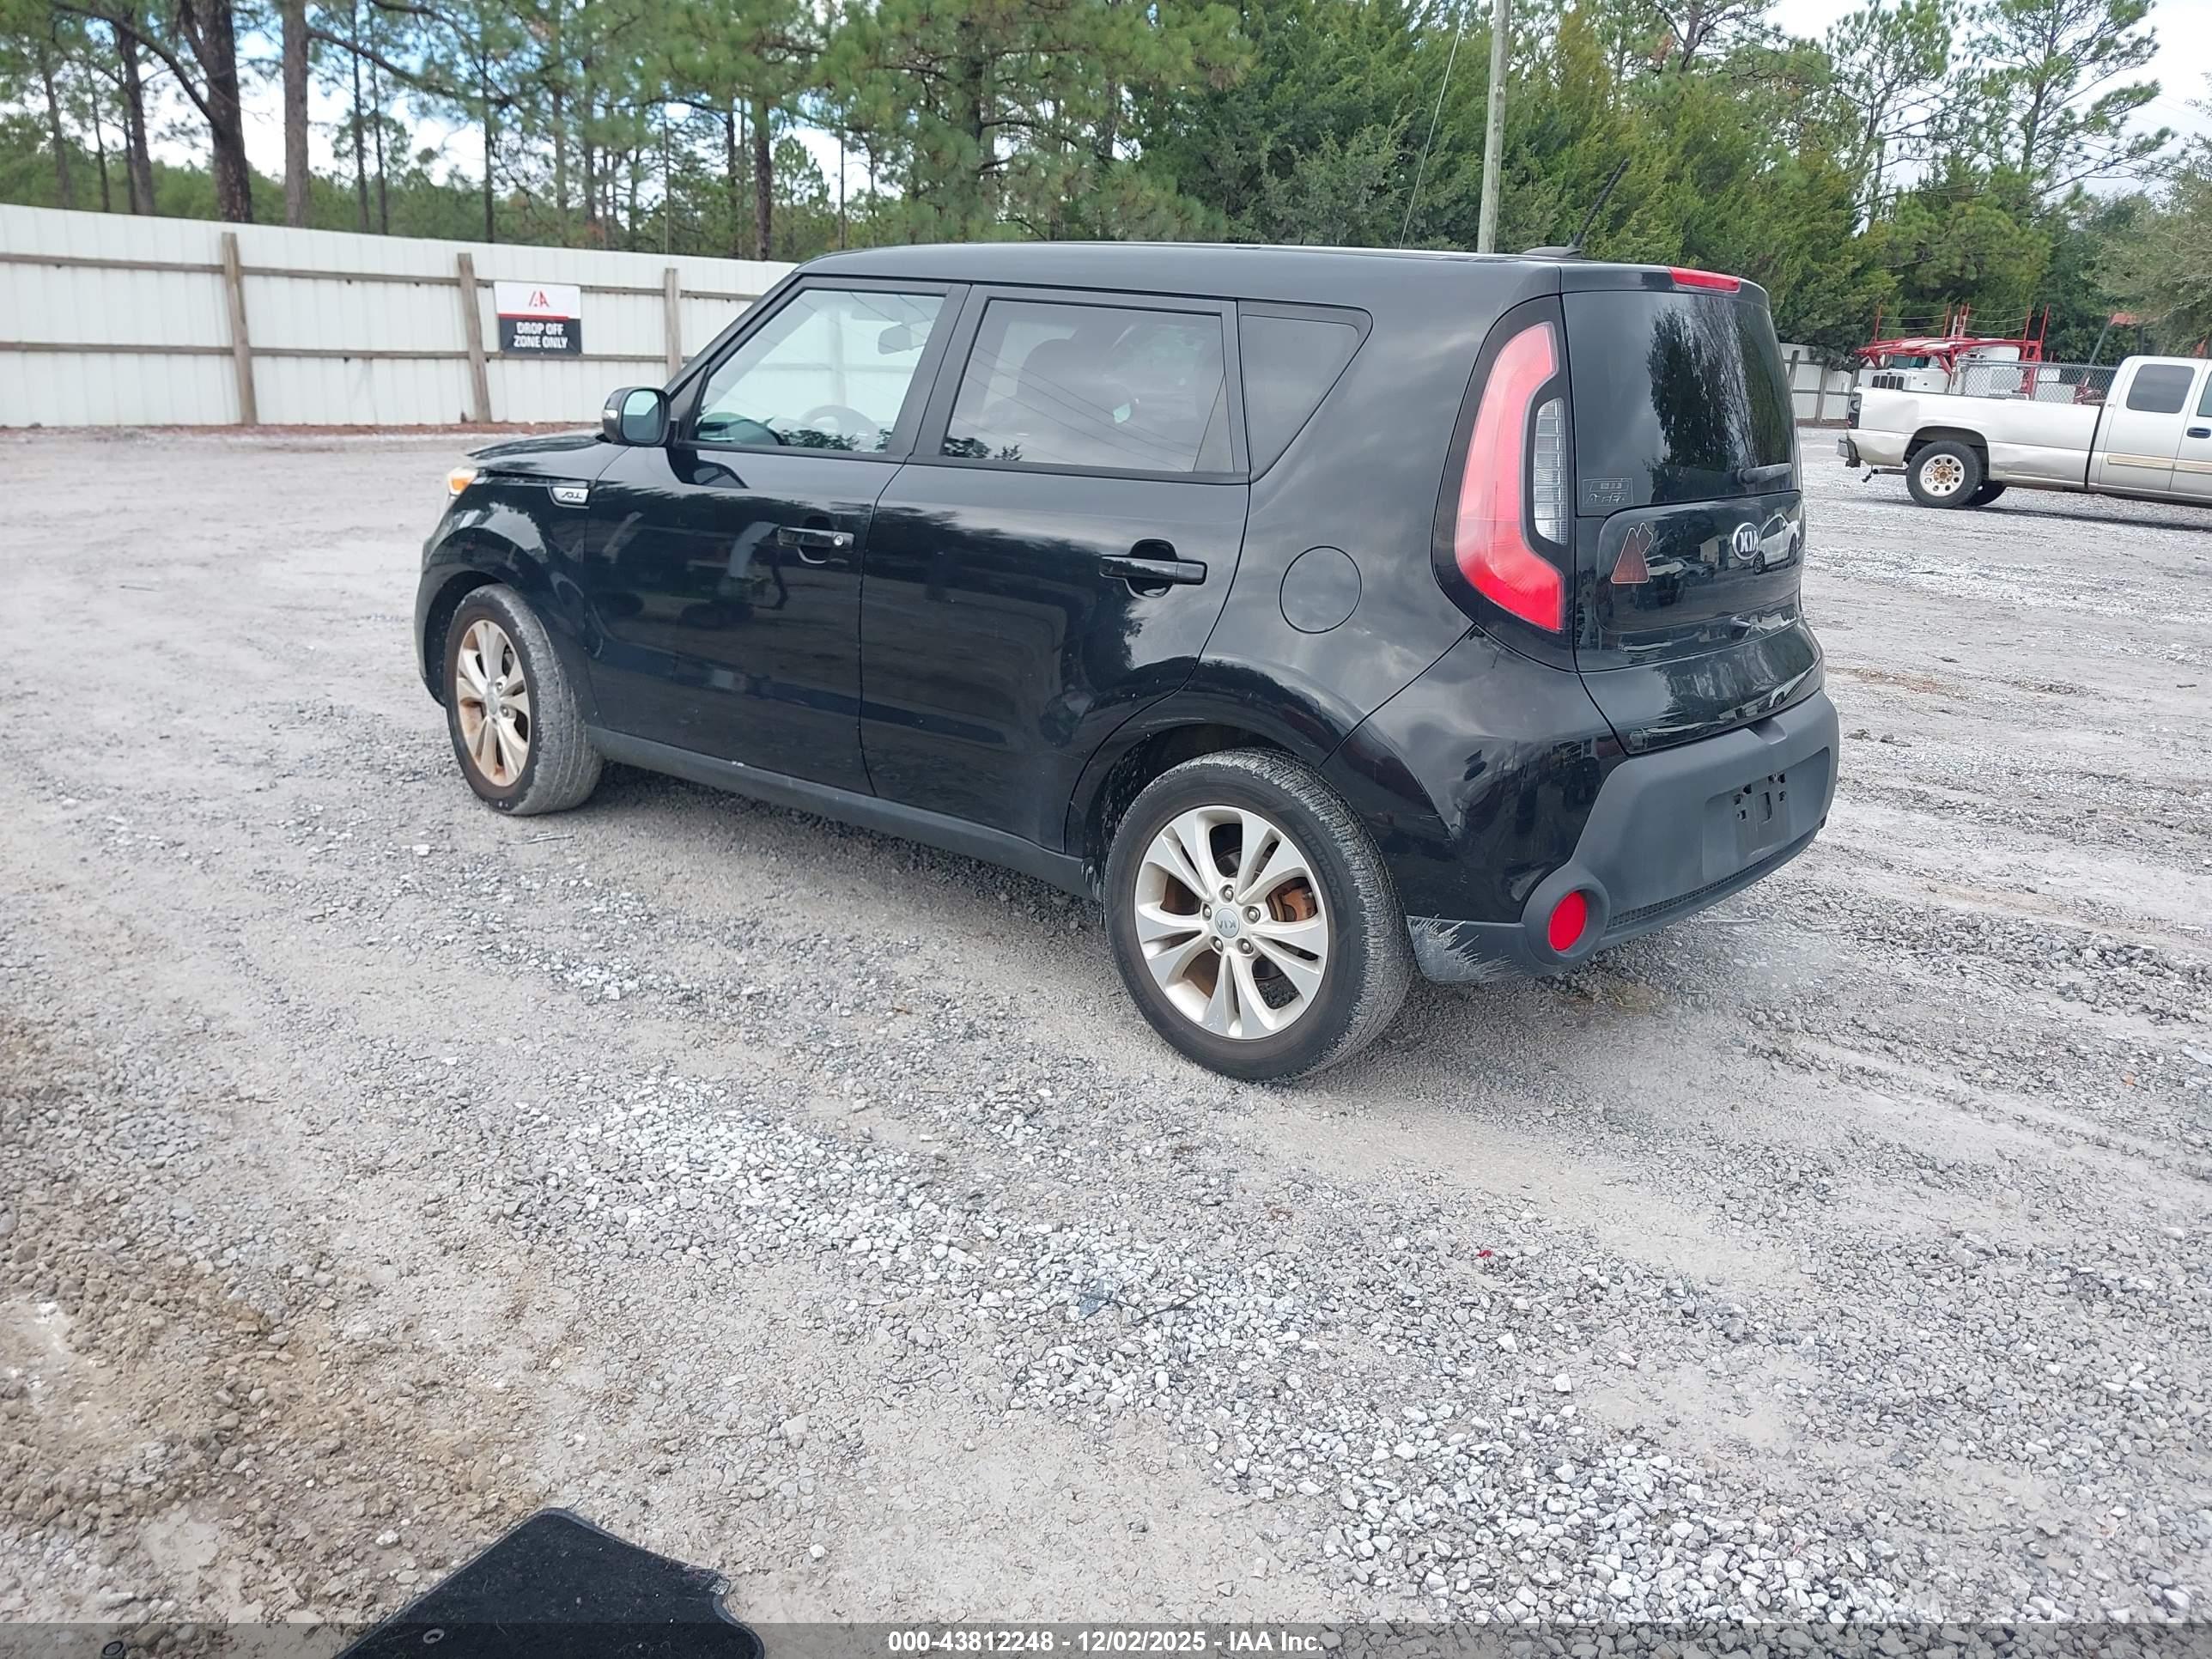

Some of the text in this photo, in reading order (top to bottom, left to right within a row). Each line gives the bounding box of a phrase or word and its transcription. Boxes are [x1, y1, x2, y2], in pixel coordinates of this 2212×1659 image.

[516, 321, 564, 336] DROP OFF
[513, 335, 568, 349] ZONE ONLY
[1739, 530, 1759, 553] KIA
